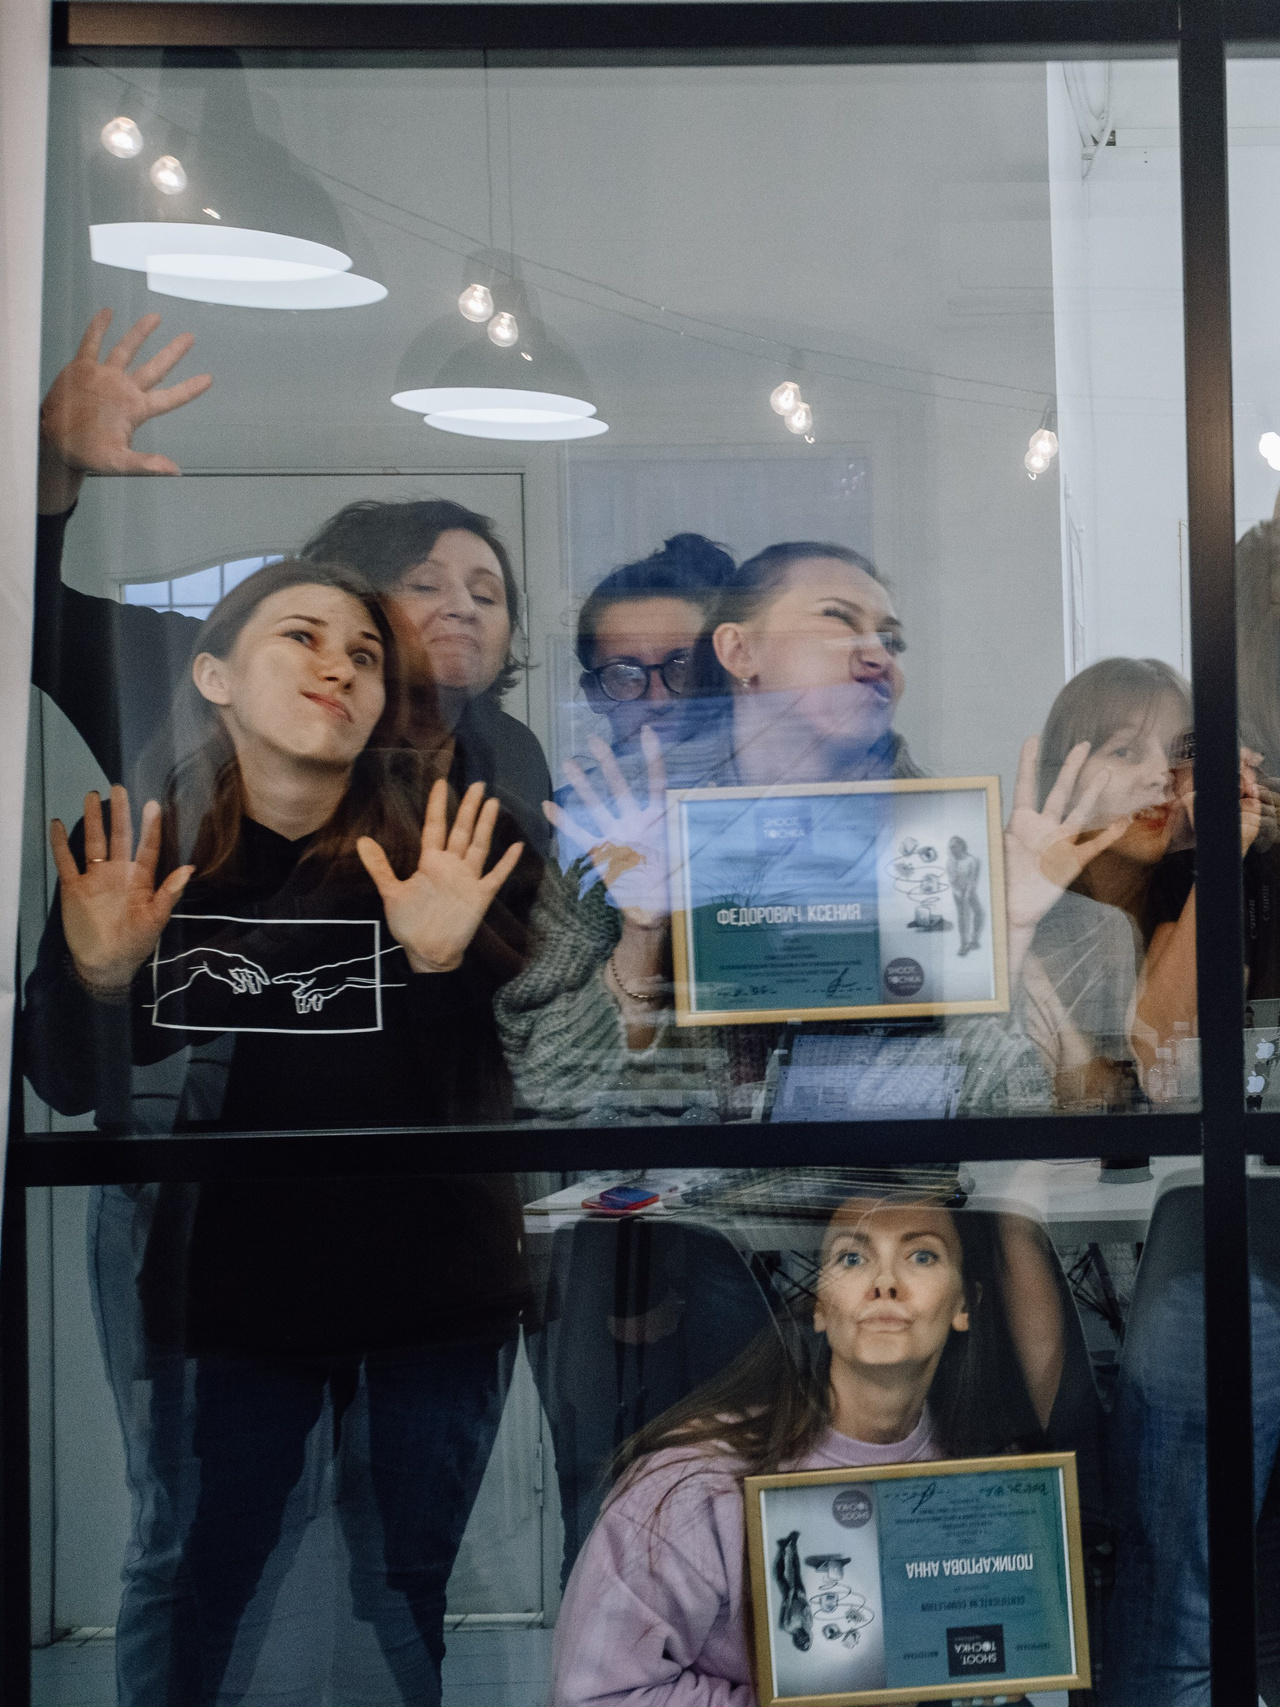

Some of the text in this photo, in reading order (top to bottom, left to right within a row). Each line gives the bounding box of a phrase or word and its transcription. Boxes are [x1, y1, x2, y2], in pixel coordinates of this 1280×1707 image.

[716, 903, 861, 926] ФЕДОРОВИЧ КСЕНИЯ
[905, 1553, 1034, 1579] ПОЛИКАРПОВА АННА
